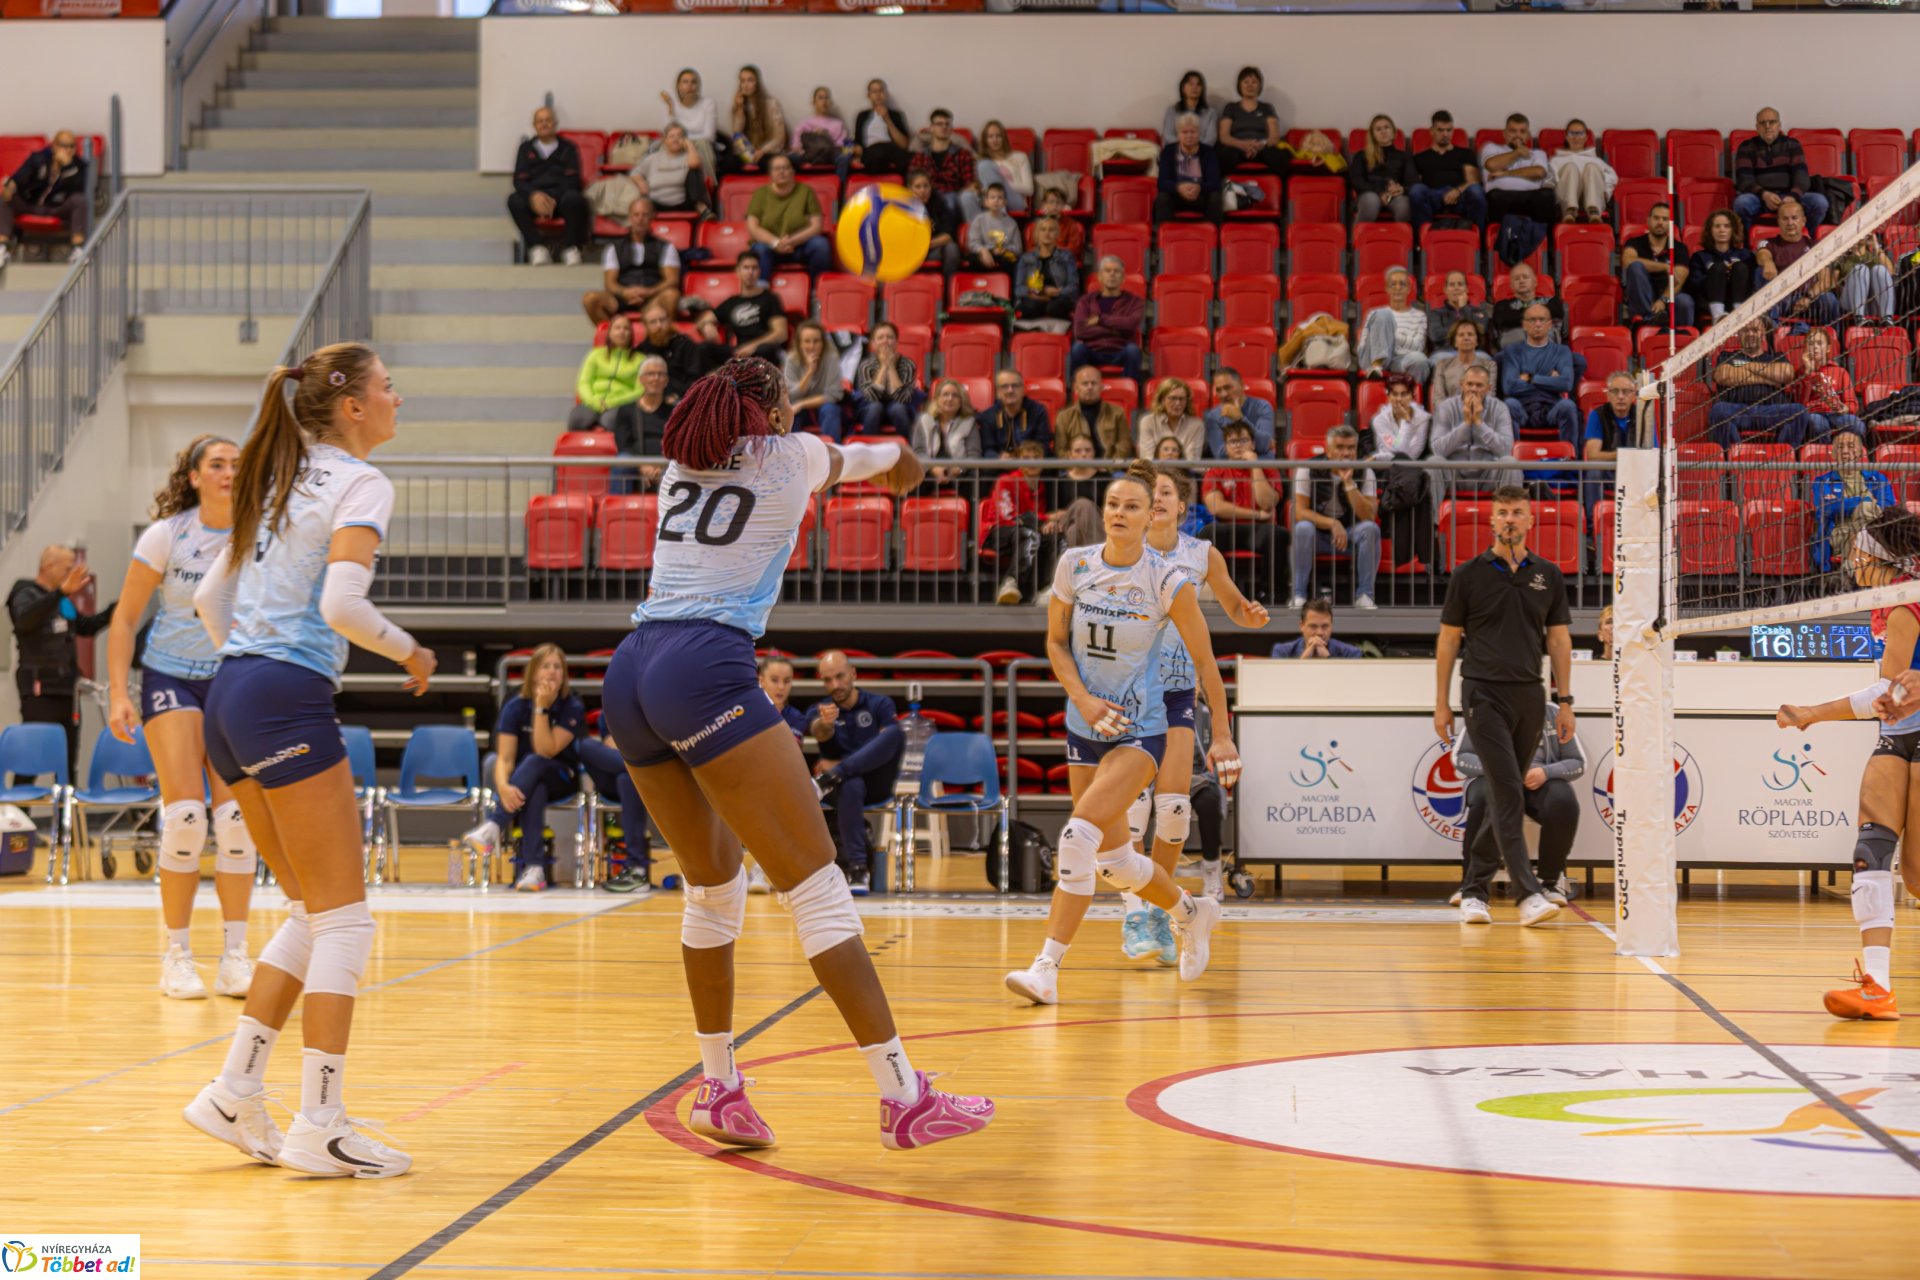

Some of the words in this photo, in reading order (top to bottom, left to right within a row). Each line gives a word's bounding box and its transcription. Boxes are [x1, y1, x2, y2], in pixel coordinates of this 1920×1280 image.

[658, 480, 756, 546] 20
[1087, 622, 1117, 654] 11
[1831, 626, 1870, 634] FATUM
[1756, 635, 1792, 657] 16
[1834, 635, 1870, 657] 12
[151, 688, 182, 711] 21
[671, 704, 745, 752] TippmixPRO
[1301, 794, 1341, 803] MAGYAR
[1773, 798, 1813, 807] MAGYAR
[1266, 802, 1377, 823] RÖPLABDA
[1420, 805, 1466, 840] NYÍRE
[1738, 806, 1850, 827] RÖPLABDA
[1296, 825, 1347, 835] SZÖVETSÉG
[1768, 829, 1820, 839] SZÖVETSÉG
